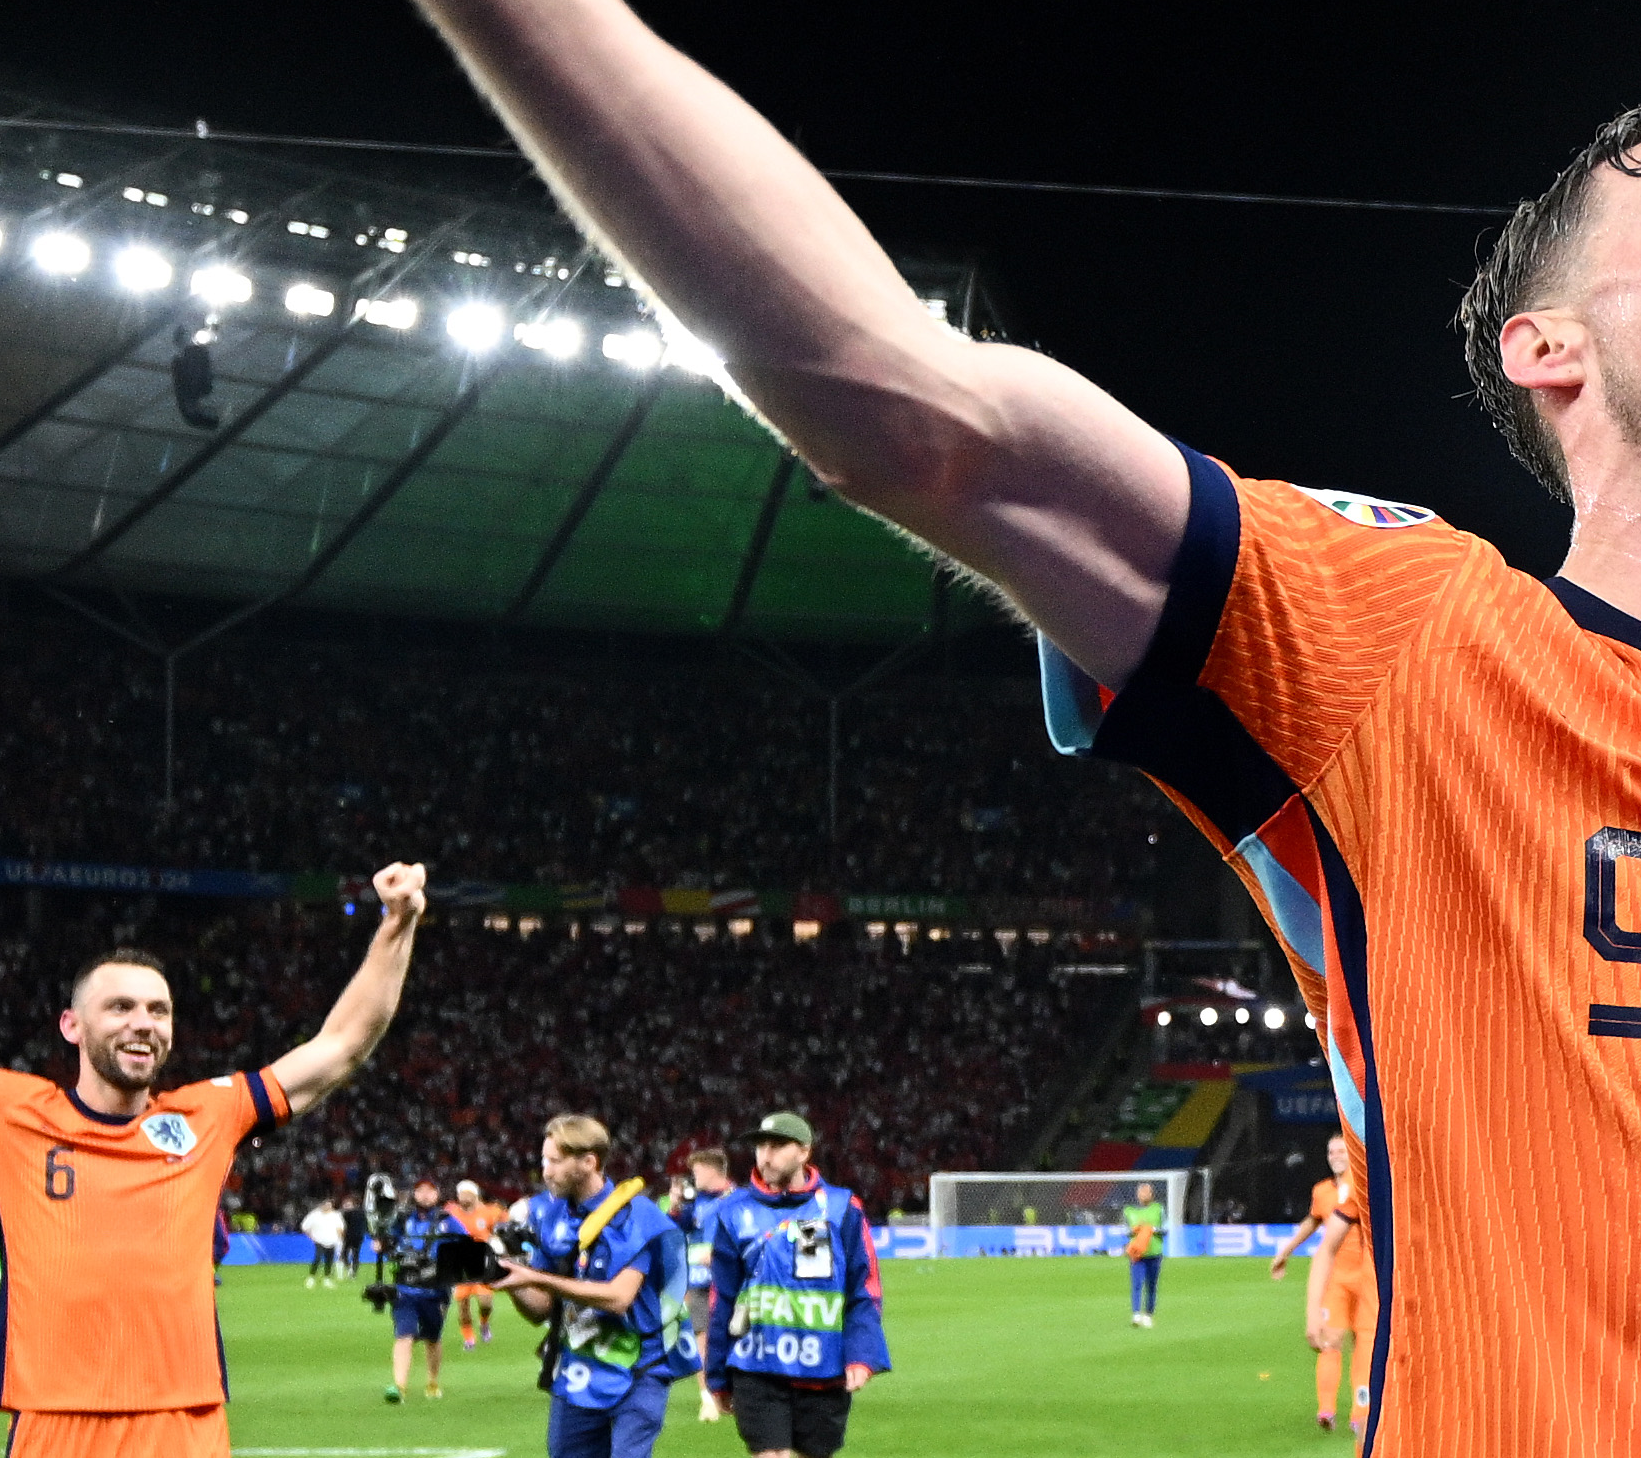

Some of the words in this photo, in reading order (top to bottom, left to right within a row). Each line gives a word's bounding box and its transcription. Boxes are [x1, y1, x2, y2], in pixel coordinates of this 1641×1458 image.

[45, 1144, 75, 1200] 6
[1213, 1226, 1323, 1255] BY
[749, 1290, 794, 1322] EFA
[797, 1294, 843, 1327] TV
[734, 1331, 821, 1368] 01-08
